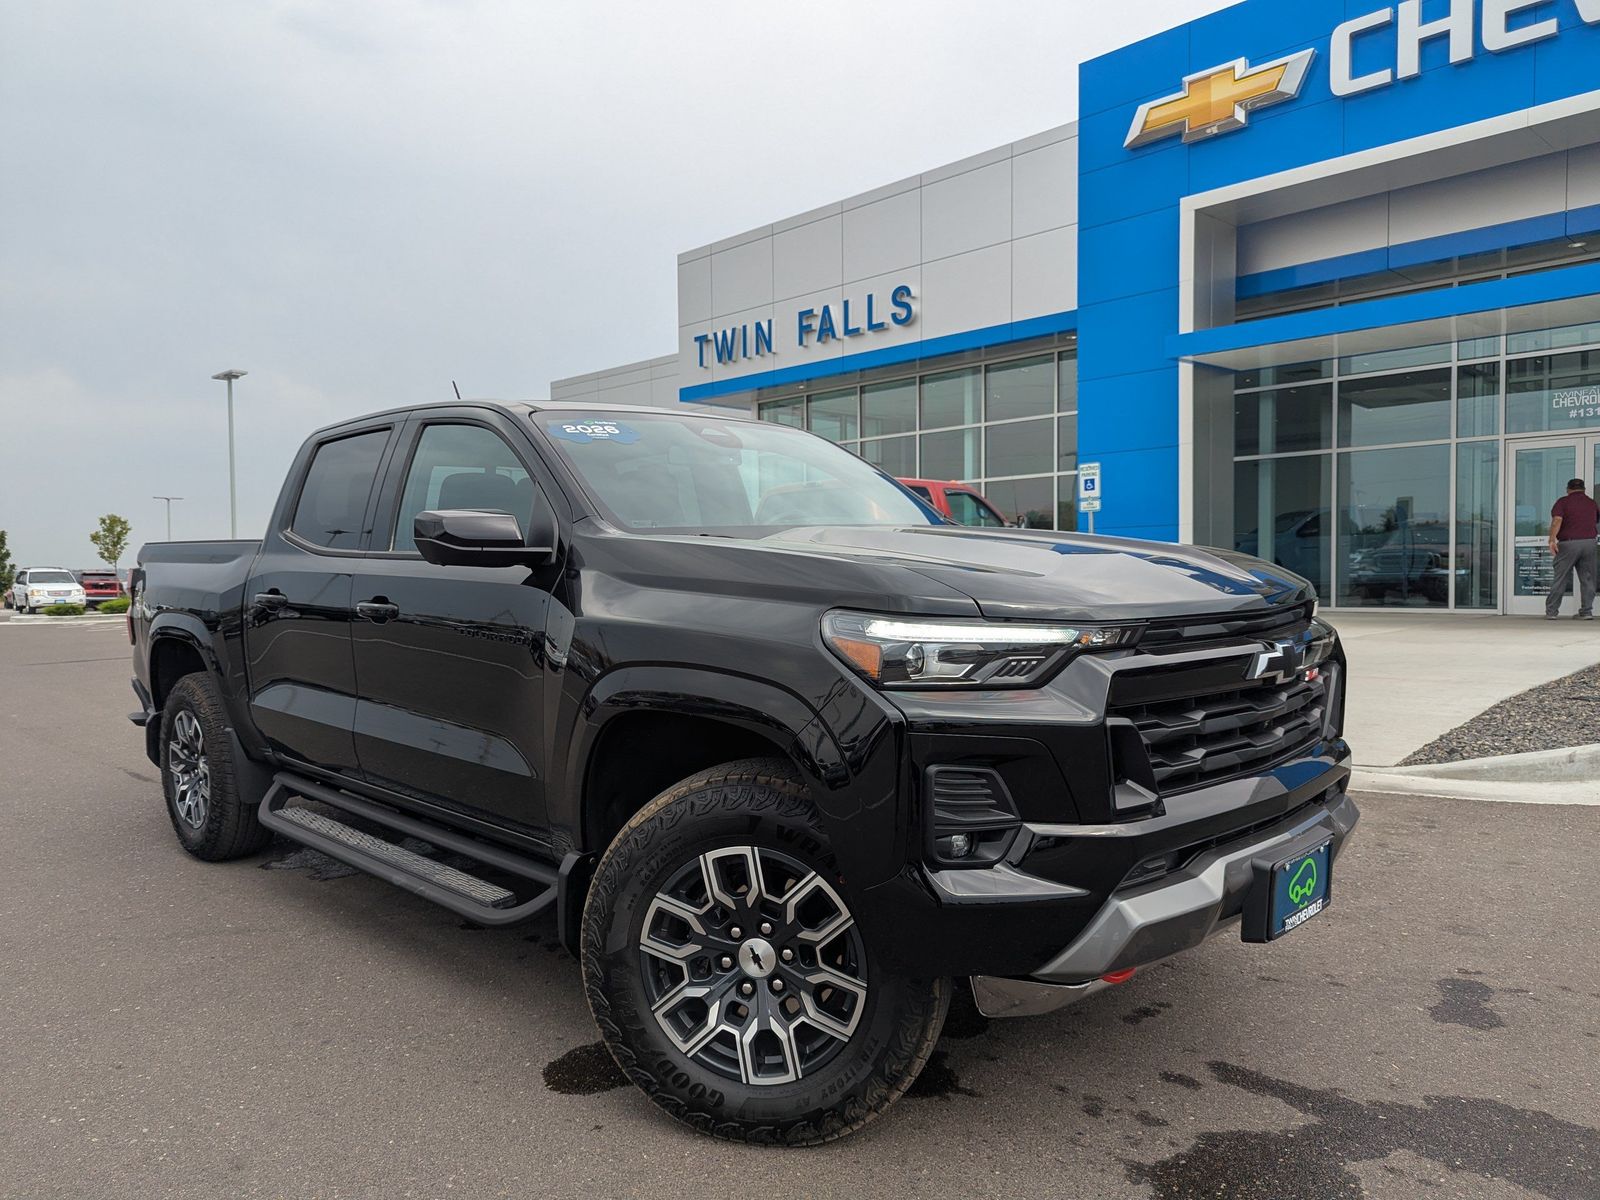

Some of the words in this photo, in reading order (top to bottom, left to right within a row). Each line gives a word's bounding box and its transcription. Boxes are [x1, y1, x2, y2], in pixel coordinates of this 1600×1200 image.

[1330, 0, 1600, 97] CHE
[694, 318, 776, 368] TWIN
[797, 284, 917, 348] FALLS
